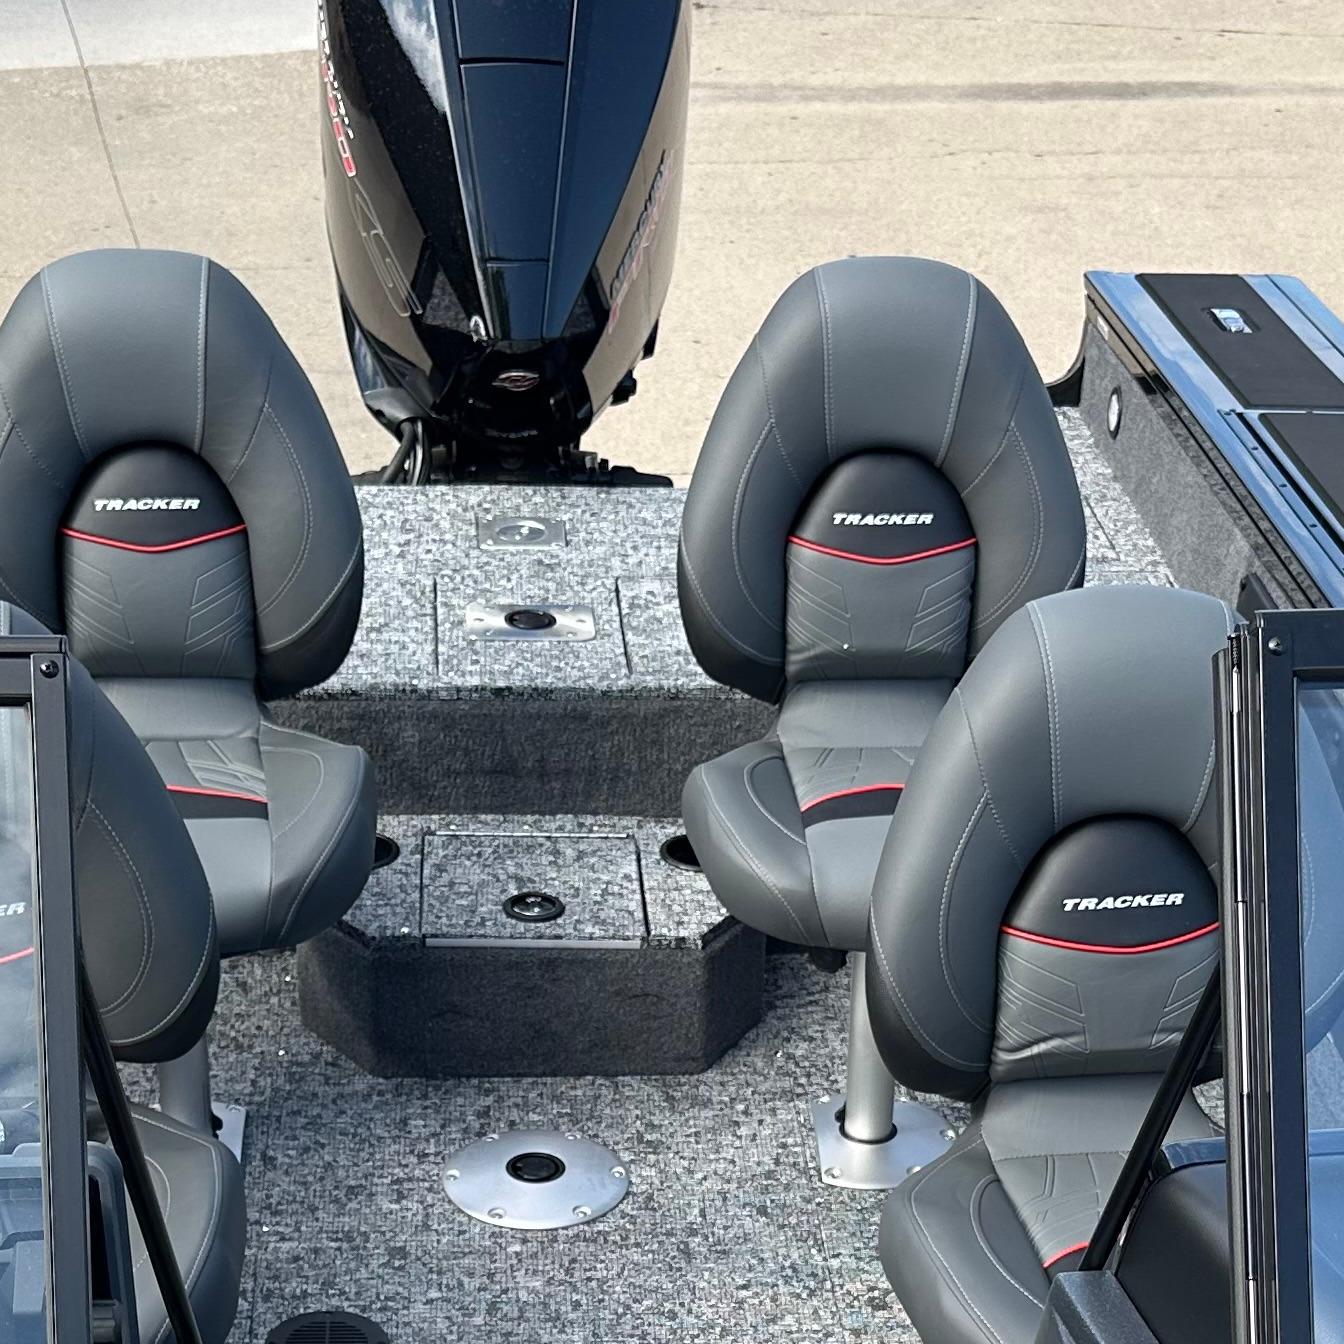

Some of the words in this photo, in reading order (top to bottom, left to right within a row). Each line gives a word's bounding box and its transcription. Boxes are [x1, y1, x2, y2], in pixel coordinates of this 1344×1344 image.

[93, 497, 200, 512] TRACKER
[832, 511, 934, 526] TRACKER
[1062, 892, 1185, 913] TRACKER
